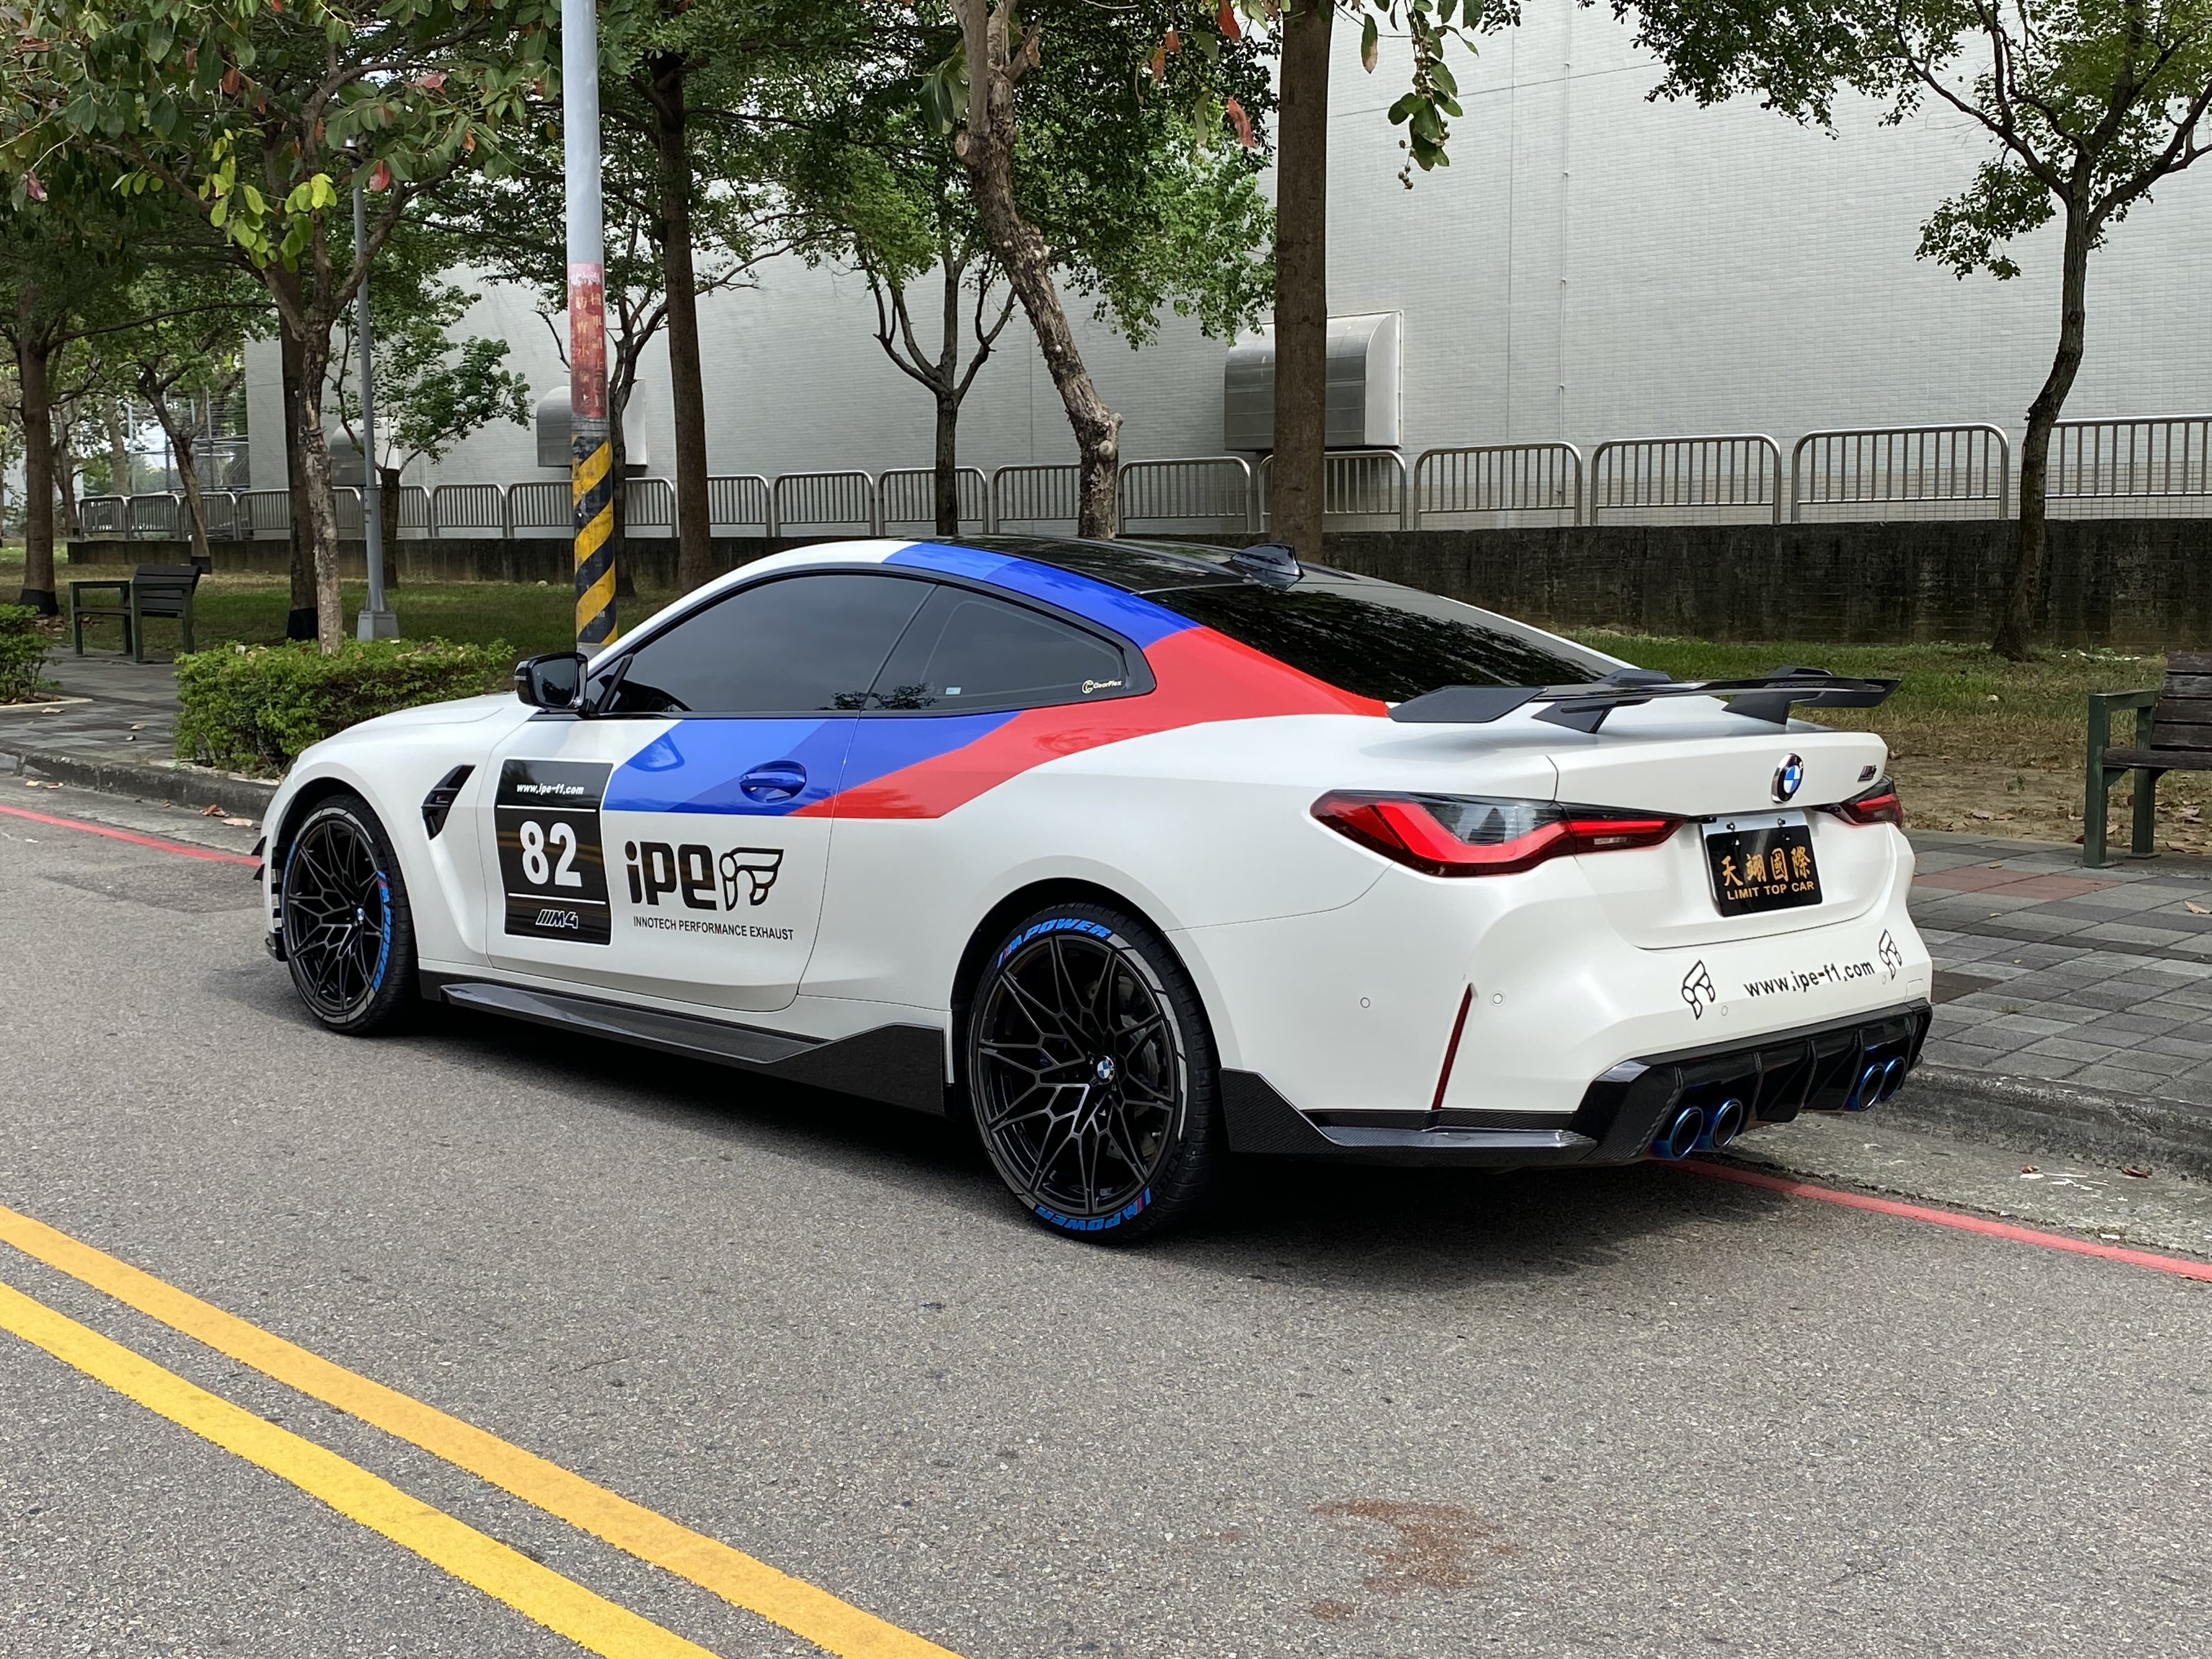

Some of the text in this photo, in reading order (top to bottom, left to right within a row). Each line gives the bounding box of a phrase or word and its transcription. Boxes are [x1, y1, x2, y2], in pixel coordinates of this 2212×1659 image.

[517, 783, 584, 795] www.ipe-f1.com
[520, 821, 582, 887] 82
[1727, 881, 1815, 900] LIMIT TOP CAR
[633, 916, 794, 940] INNOTECH PERFORMANCE EXHAUST
[1743, 961, 1875, 997] www.ipe-f1.com
